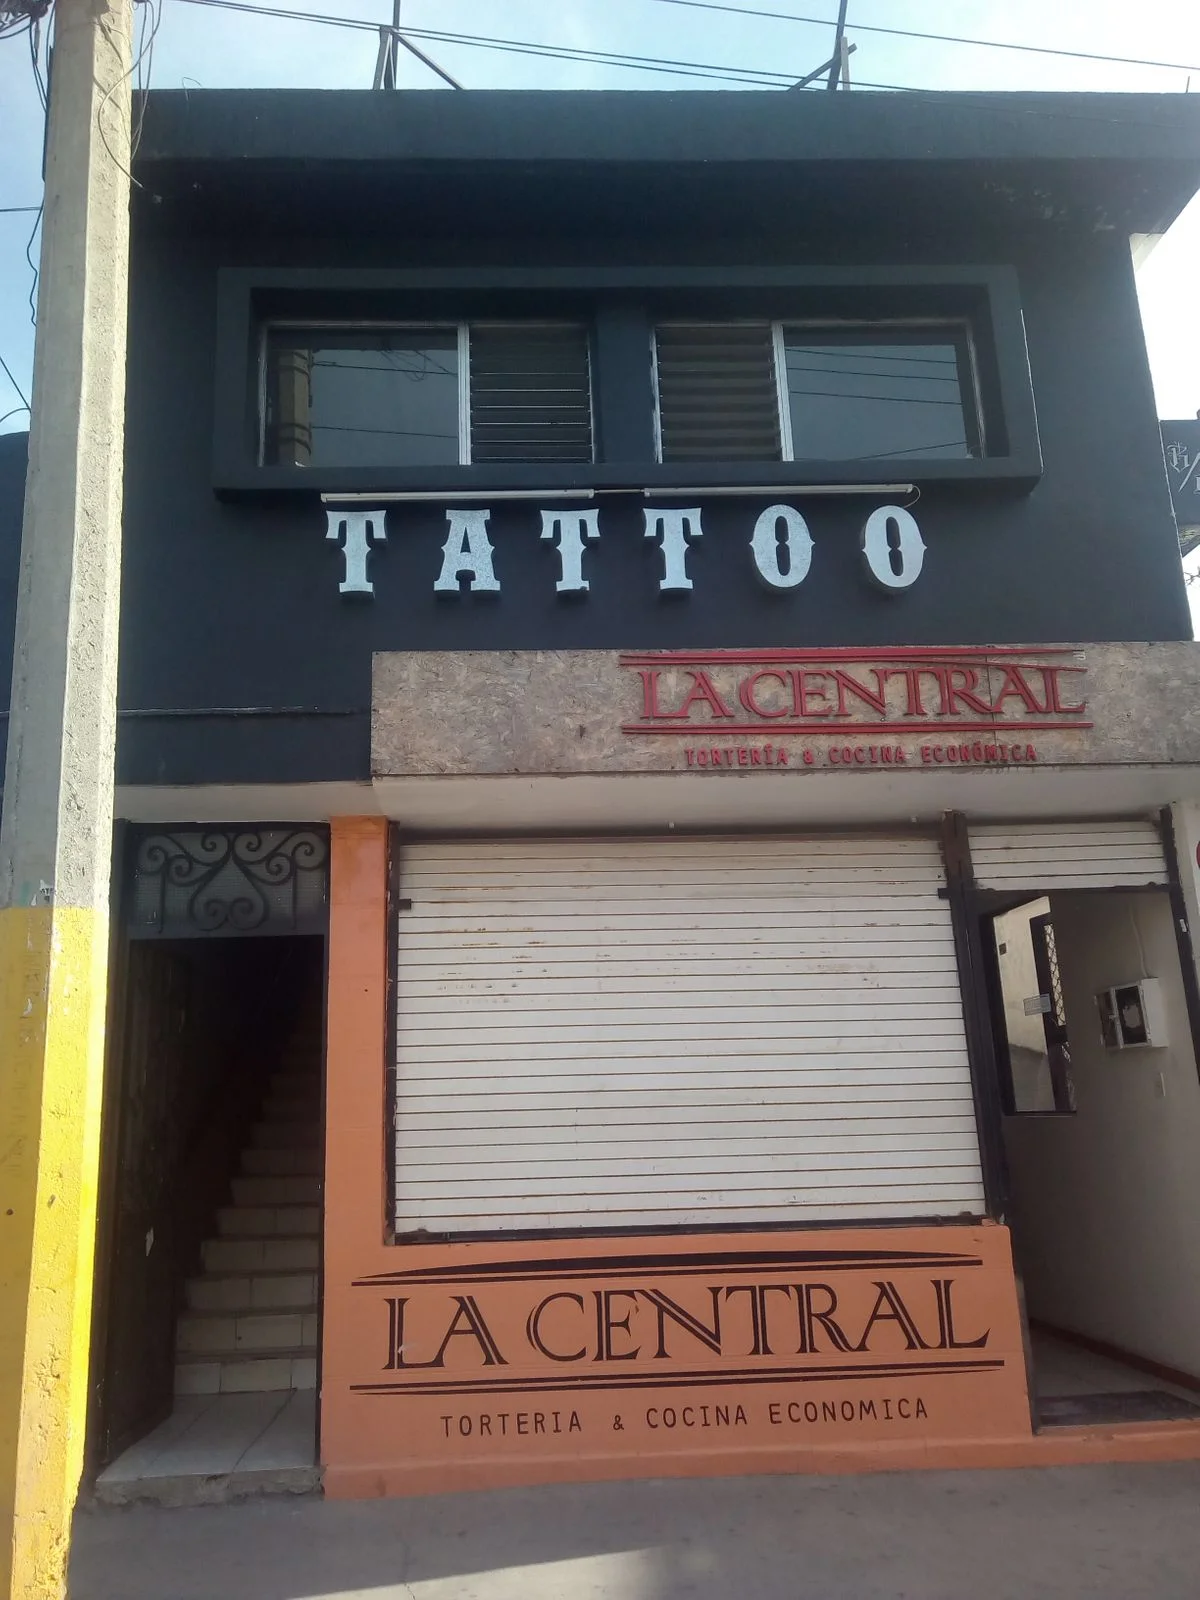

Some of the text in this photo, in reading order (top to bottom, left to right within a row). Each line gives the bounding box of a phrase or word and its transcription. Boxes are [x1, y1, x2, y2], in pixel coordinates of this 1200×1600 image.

[326, 505, 927, 593] TATTOO
[638, 664, 1086, 719] LA CENTRAL
[803, 750, 814, 764] &
[828, 746, 905, 764] COCINA
[382, 1279, 990, 1370] LA CENTRAL
[440, 1397, 929, 1438] TORTERIA & COCINA ECONOMICA
